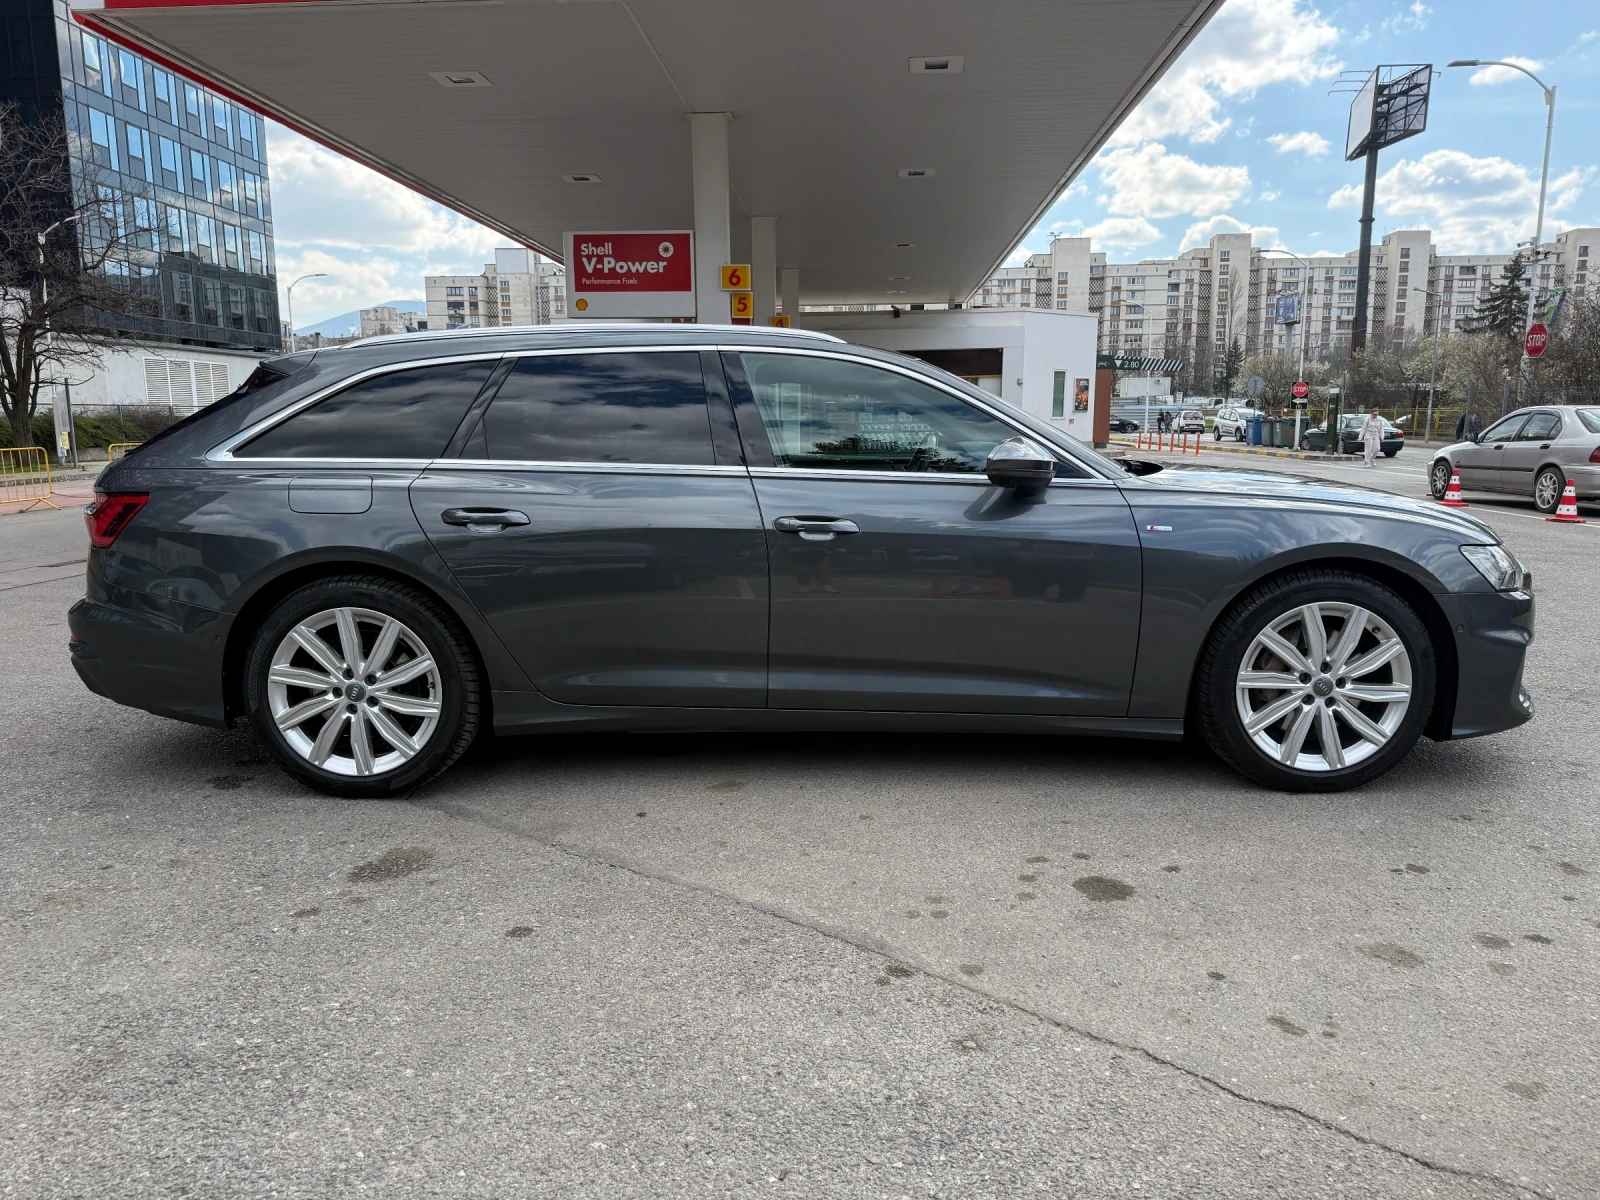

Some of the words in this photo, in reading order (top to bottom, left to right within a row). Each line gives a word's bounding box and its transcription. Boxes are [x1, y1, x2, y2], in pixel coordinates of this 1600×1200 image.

[580, 242, 613, 256] Shell
[581, 257, 668, 274] V-Power
[581, 277, 621, 285] Performance
[622, 277, 638, 285] Fuels
[728, 268, 742, 287] 6
[736, 297, 748, 313] 5
[775, 318, 785, 328] 4
[1527, 334, 1546, 347] STOP
[1123, 360, 1140, 369] 2.80
